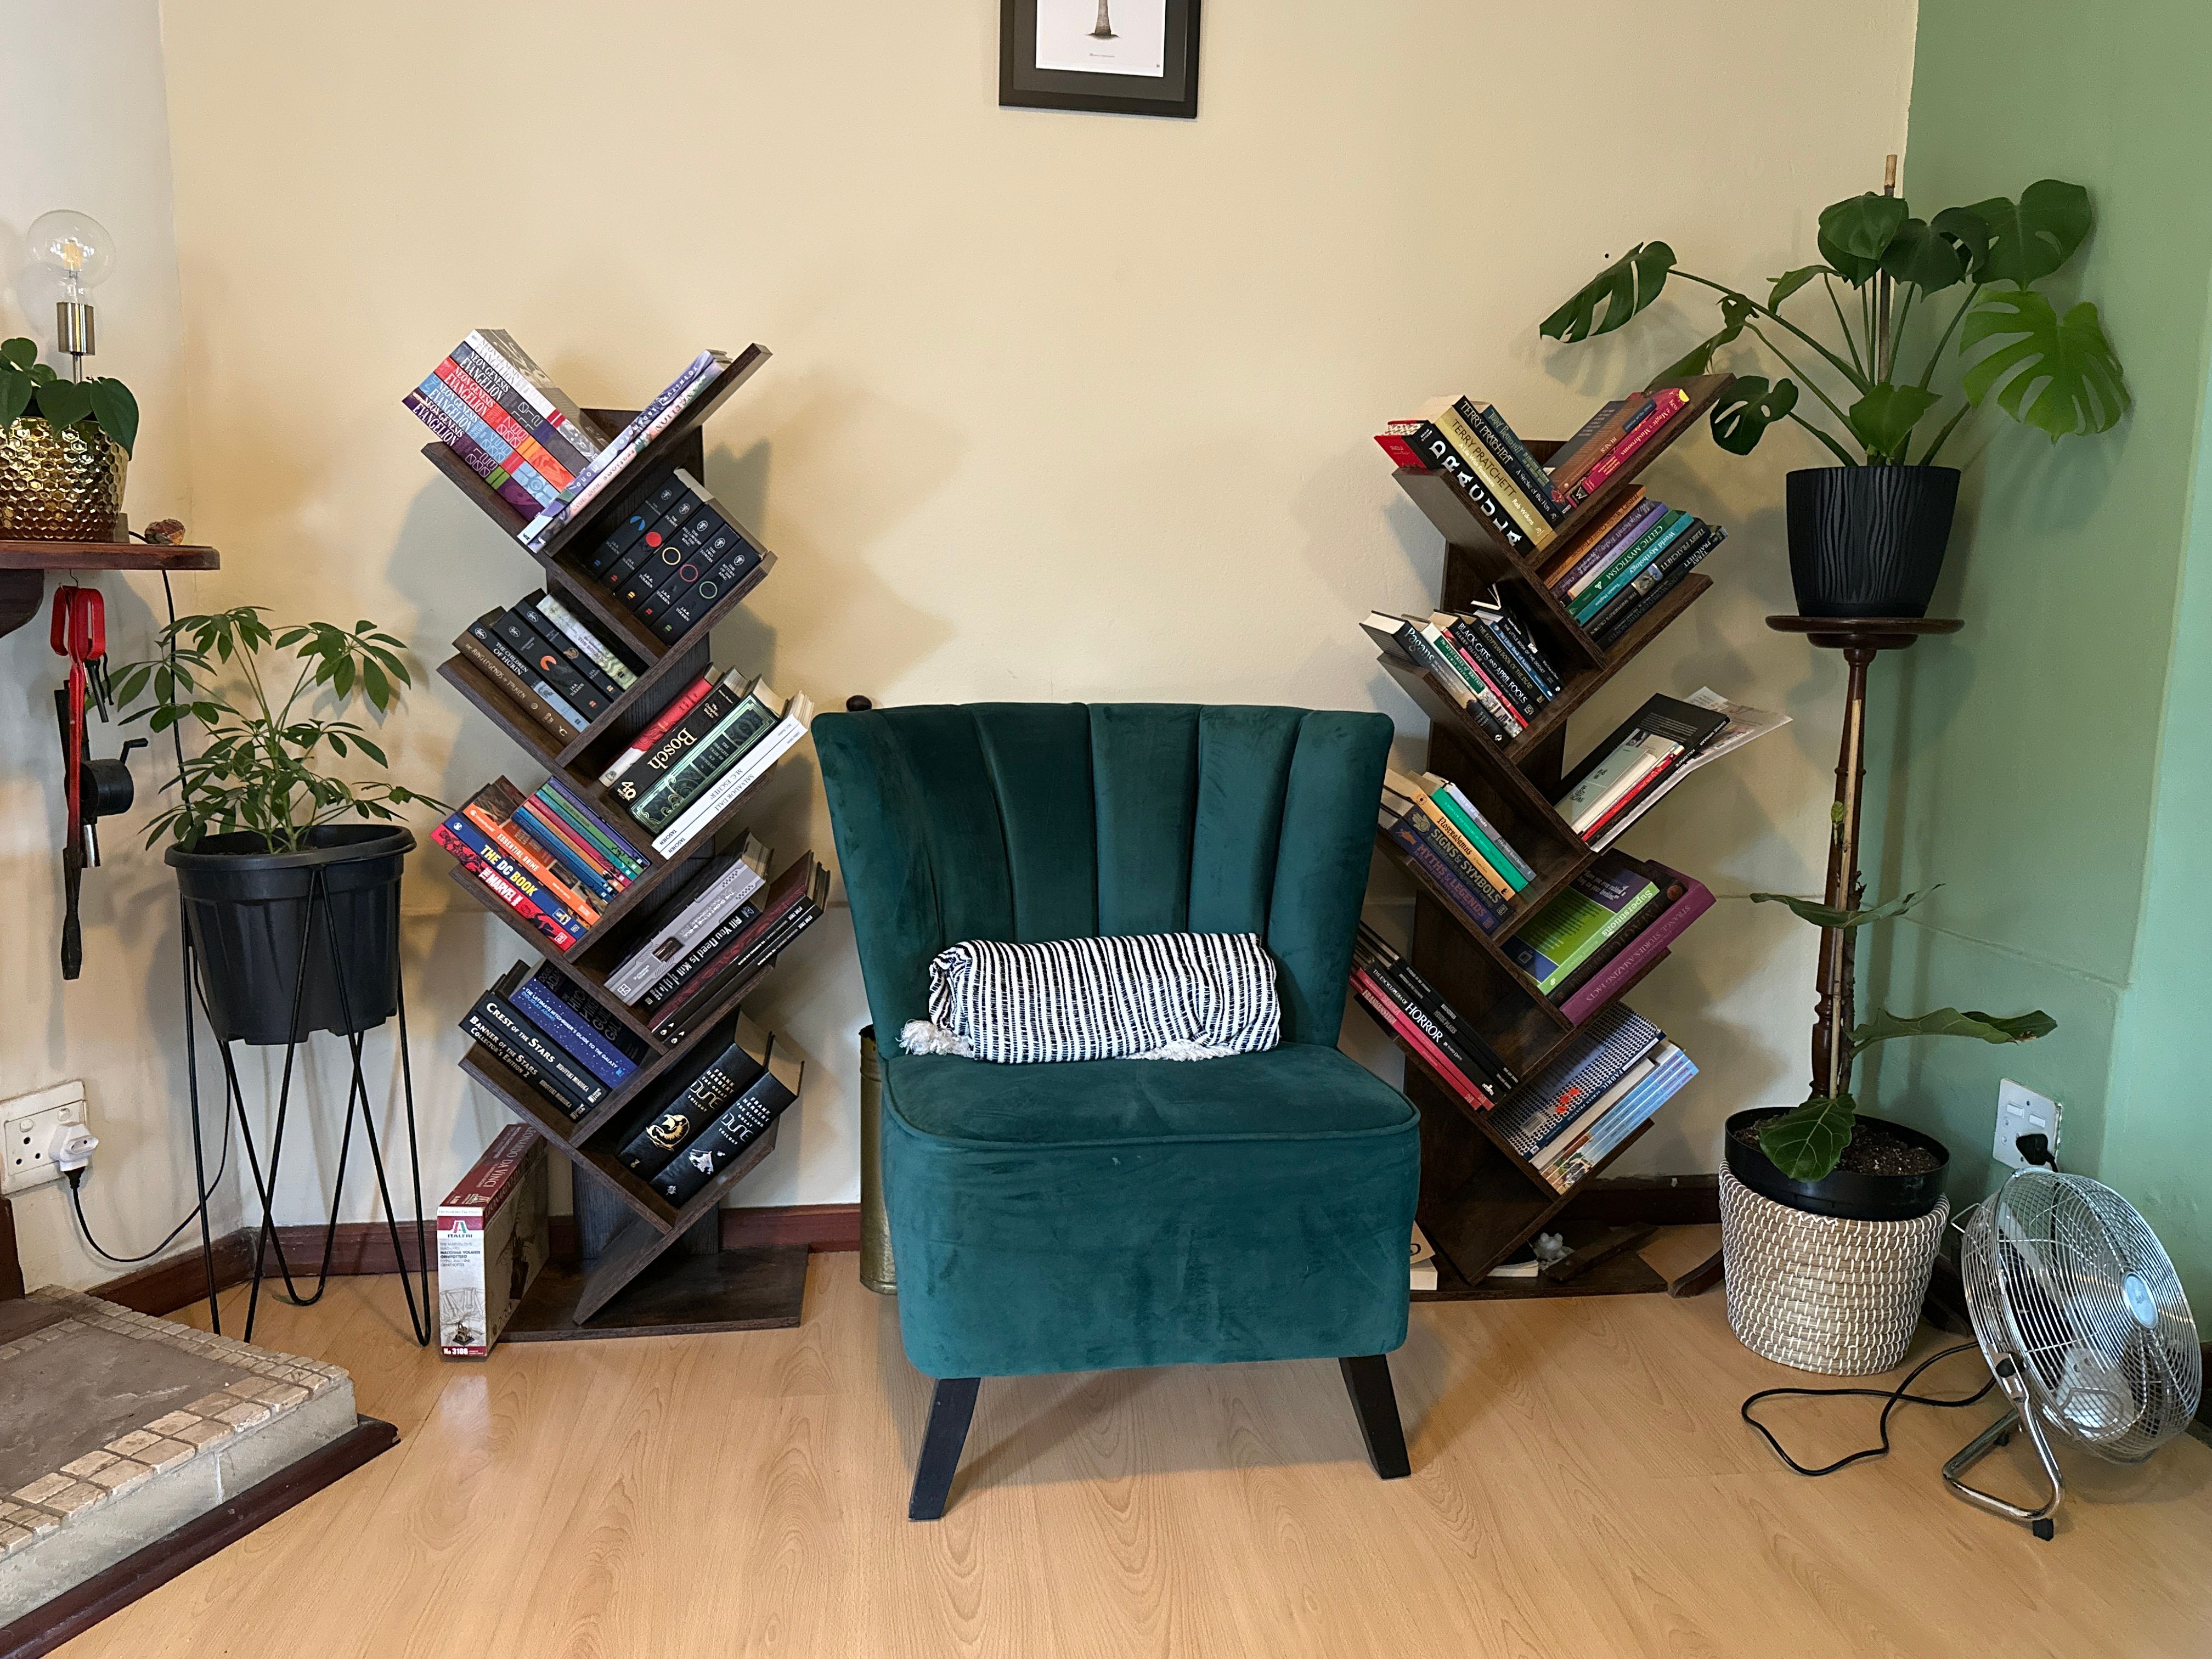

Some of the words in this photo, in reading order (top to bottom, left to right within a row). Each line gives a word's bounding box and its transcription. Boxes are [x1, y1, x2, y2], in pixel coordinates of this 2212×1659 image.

[458, 357, 505, 402] EVANGELION
[466, 350, 488, 370] NEON
[482, 364, 511, 393] GENESIS
[436, 381, 457, 402] NEON
[452, 397, 479, 424] GENESIS
[443, 372, 490, 417] EVANGELION
[452, 366, 473, 387] NEON
[467, 381, 496, 409] GENESIS
[411, 402, 458, 447] EVANGELION
[421, 397, 441, 416] NEON
[436, 411, 465, 438] GENESIS
[427, 387, 474, 432] EVANGELION
[1651, 410, 1669, 428] Magic
[1457, 400, 1485, 430] TERRY
[1476, 425, 1515, 466] PRATCHETT
[1619, 427, 1652, 457] Mushrooms
[1448, 419, 1477, 450] TERRY
[1470, 447, 1519, 499] PRATCHETT
[1460, 446, 1471, 457] Life
[1467, 454, 1480, 467] With
[1475, 465, 1497, 487] Footnotes
[1425, 438, 1526, 548] DRACULA
[1510, 498, 1523, 510] Rob
[1518, 507, 1536, 526] Wilkins
[1638, 523, 1664, 548] CELTIC
[1655, 529, 1677, 549] World
[1603, 544, 1643, 580] MYSTICISM
[1626, 545, 1660, 575] Mythology
[1681, 539, 1713, 568] PRATCHETT
[1690, 549, 1709, 566] TERRY
[1398, 627, 1439, 667] Pagans
[1453, 630, 1470, 646] HARRY
[1465, 644, 1484, 663] OLIVER
[1455, 622, 1479, 646] BLACK
[1498, 630, 1507, 639] The
[1503, 636, 1515, 648] Little
[1511, 646, 1521, 656] Book
[1503, 623, 1511, 631] THE
[1508, 630, 1519, 642] LITTLE
[1527, 653, 1536, 662] THE
[492, 647, 503, 658] OF
[494, 641, 507, 654] THE
[504, 650, 529, 673] CHILDREN
[1472, 641, 1492, 661] CATS
[1477, 624, 1488, 635] THE
[1483, 632, 1504, 653] EGYPTIAN
[1499, 651, 1513, 664] BOOK
[1509, 662, 1517, 670] OF
[1515, 668, 1524, 678] THE
[1520, 675, 1534, 690] DEAD
[1487, 657, 1498, 669] AND
[1443, 644, 1466, 667] MYSTERIES
[1462, 664, 1470, 673] of
[1466, 670, 1485, 689] BRITAIN
[1492, 665, 1513, 686] APRIL
[1506, 680, 1530, 704] FOOLS
[645, 726, 698, 775] Bosch
[725, 772, 755, 800] SALVADOR
[658, 827, 678, 846] TASCHEN
[667, 836, 686, 854] TASCHEN
[1436, 816, 1474, 856] Nostradamus
[495, 832, 525, 859] ESSENTIAL
[521, 855, 540, 872] ANIME
[1429, 827, 1459, 859] SIGNS
[1453, 854, 1463, 864] &
[1459, 860, 1502, 905] SYMBOLS
[479, 844, 502, 866] THE
[495, 859, 515, 877] DC
[509, 870, 538, 898] BOOK
[1416, 843, 1448, 877] MYTHS
[1443, 873, 1453, 883] &
[1448, 878, 1487, 918] LEGENDS
[484, 872, 518, 903] MARVEL
[727, 914, 743, 929] All
[1598, 888, 1655, 938] Superstitions
[695, 935, 719, 958] Need
[713, 924, 732, 942] You
[675, 960, 692, 978] Kill
[687, 952, 701, 966] Is
[1602, 955, 1637, 985] AMAZING
[1372, 968, 1381, 978] THE
[1404, 1001, 1445, 1043] HORROR
[1584, 982, 1607, 1002] FACTS
[524, 987, 534, 996] THE
[531, 993, 552, 1012] ULTIMATE
[574, 1031, 590, 1045] GUIDE
[588, 1042, 596, 1050] TO
[594, 1047, 603, 1056] THE
[600, 1053, 618, 1069] GALAXY
[540, 1007, 556, 1022] ADAMS
[469, 1014, 501, 1044] BANNER
[498, 1040, 507, 1049] OF
[504, 1046, 517, 1058] THE
[515, 1054, 539, 1076] STARS
[484, 1001, 515, 1029] CREST
[510, 1025, 520, 1035] OF
[517, 1031, 529, 1042] THE
[527, 1036, 557, 1064] STARS
[470, 1026, 504, 1057] COLLECTOR'S
[501, 1053, 524, 1074] EDITION
[522, 1070, 530, 1079] 2
[701, 1075, 712, 1086] THE
[711, 1084, 728, 1099] GREAT
[705, 1069, 734, 1095] HERBERT
[713, 1068, 735, 1088] FRANK
[1599, 1068, 1624, 1092] FABRIC
[686, 1094, 708, 1113] TRILOGY
[688, 1078, 724, 1111] DUNE
[749, 1096, 771, 1116] FRANK
[1584, 1089, 1601, 1105] SCREEN
[735, 1102, 746, 1113] THE
[746, 1111, 764, 1128] SECOND
[737, 1113, 753, 1128] GREAT
[742, 1097, 770, 1123] HERBERT
[718, 1127, 738, 1146] TRILOGY
[719, 1111, 754, 1144] DUNE
